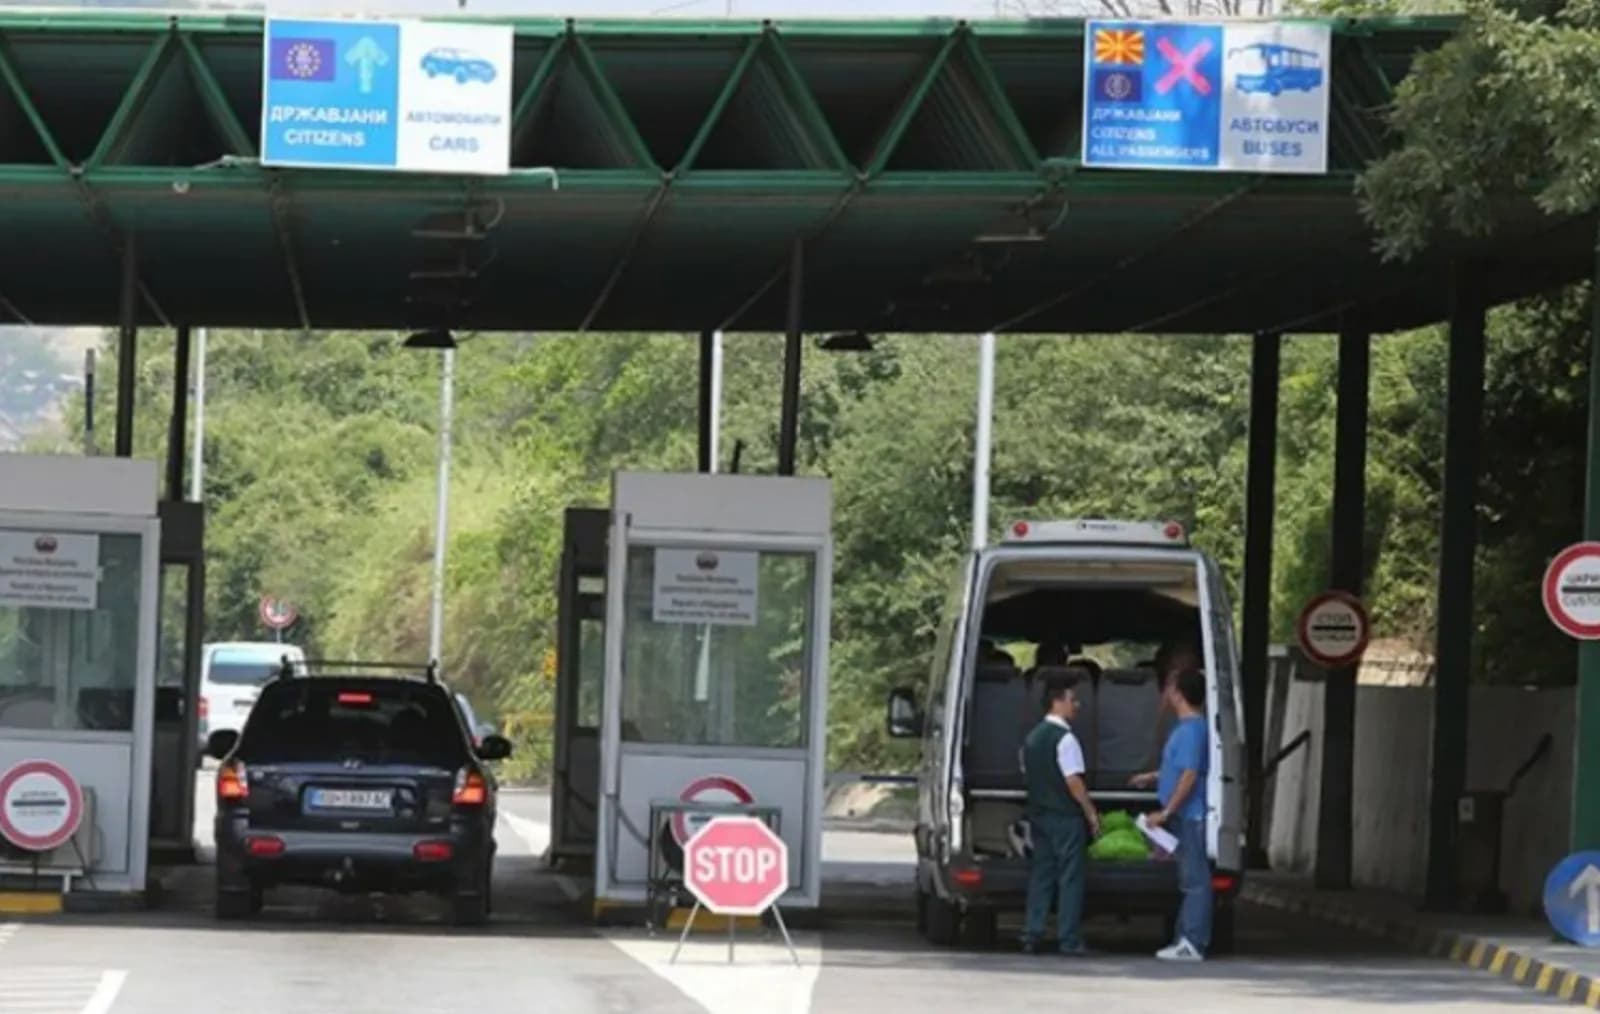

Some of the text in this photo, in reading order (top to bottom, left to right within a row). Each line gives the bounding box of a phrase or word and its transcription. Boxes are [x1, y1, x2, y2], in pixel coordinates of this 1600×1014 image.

[271, 105, 389, 125] ДРЖАВЈАНИ
[1229, 118, 1320, 135] АВТОБУСИ
[284, 128, 366, 148] CITIZENS
[428, 135, 481, 154] CARS
[1242, 139, 1304, 157] BUSES
[695, 845, 777, 884] STOP
